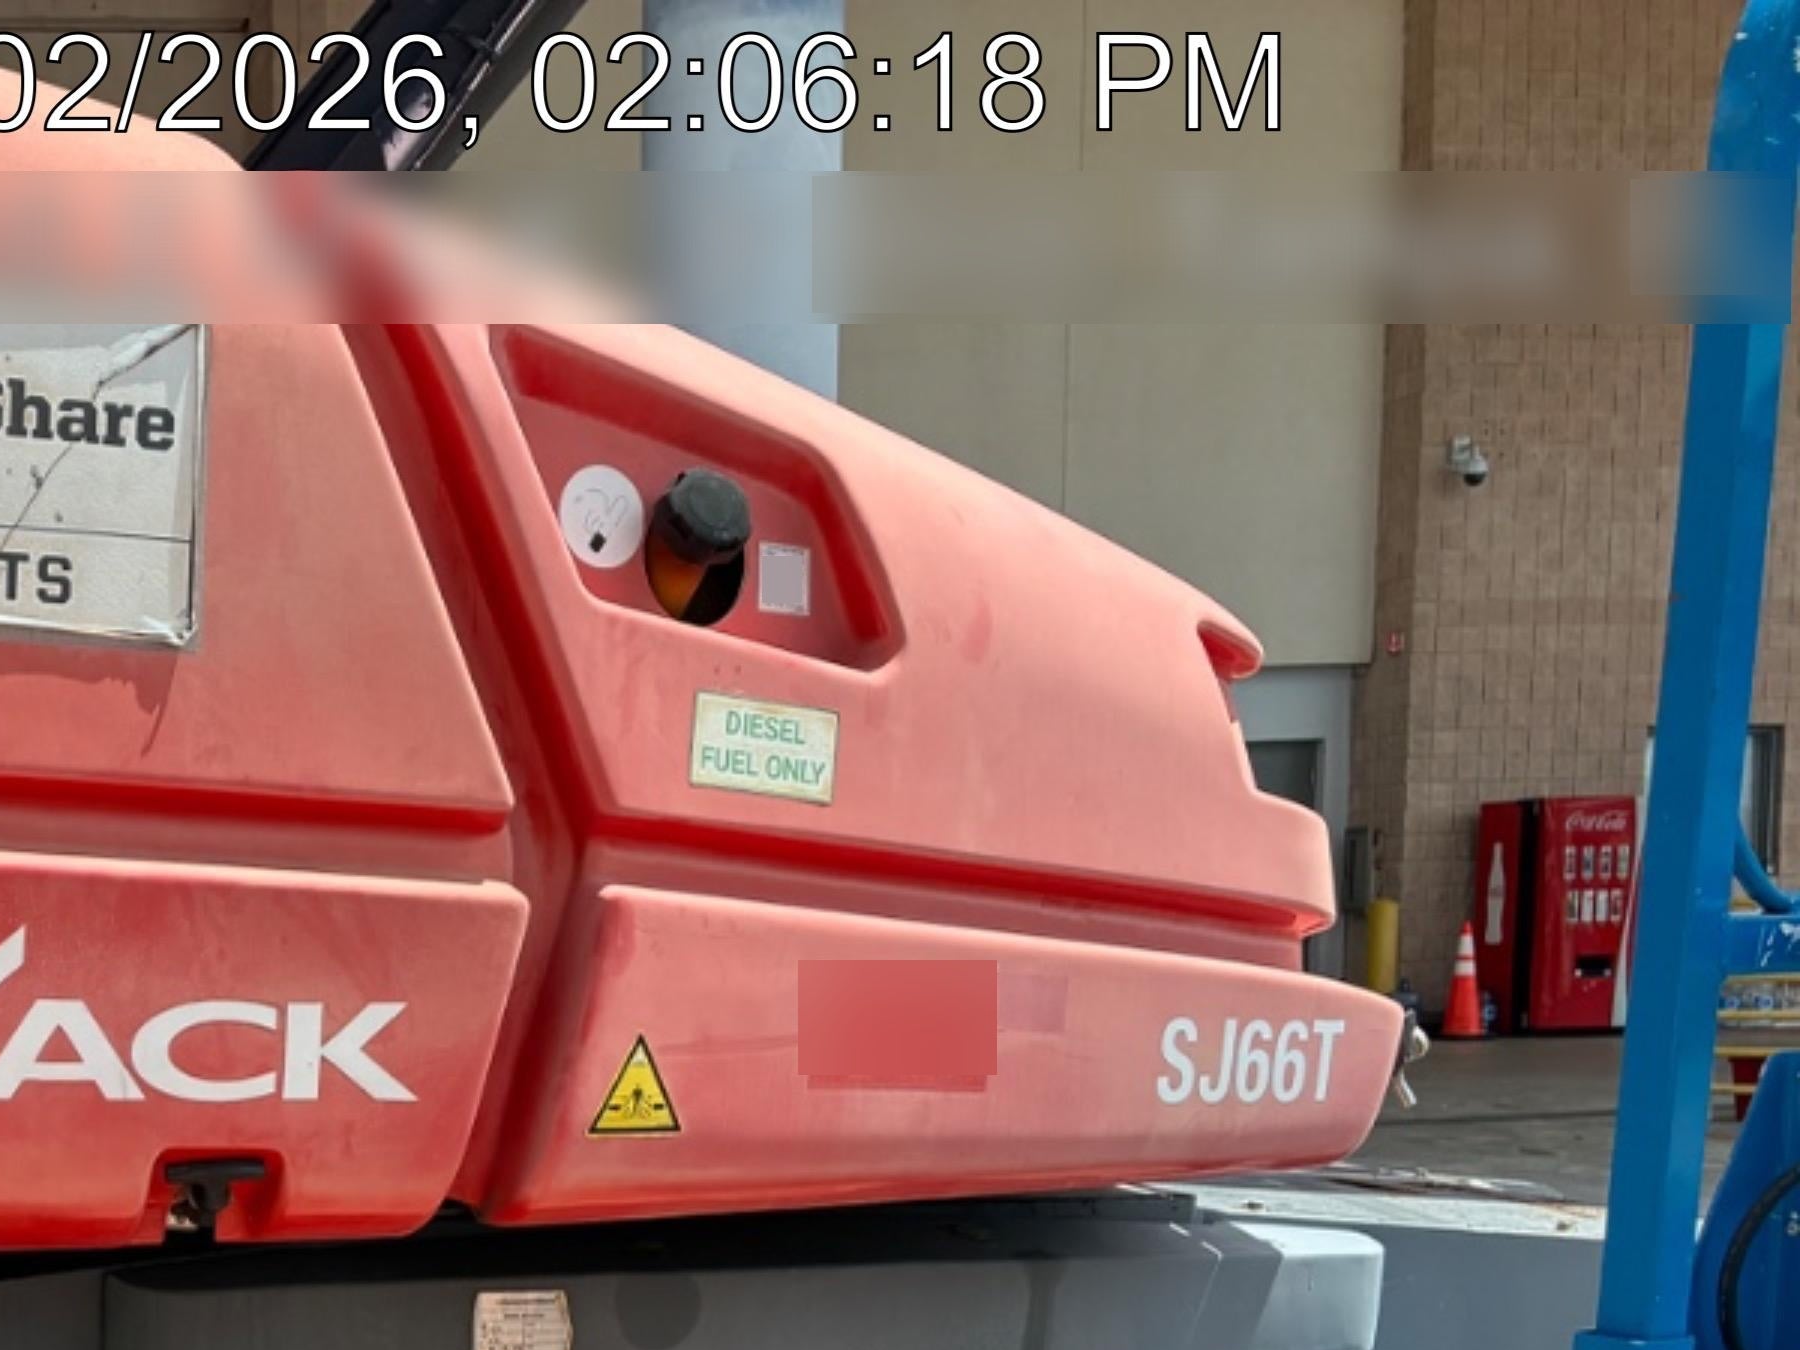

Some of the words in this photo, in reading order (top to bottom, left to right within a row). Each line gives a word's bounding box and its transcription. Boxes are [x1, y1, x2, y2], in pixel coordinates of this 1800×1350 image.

[726, 710, 805, 745] DIESEL
[701, 746, 758, 776] FUEL
[766, 755, 825, 785] ONLY
[1155, 1016, 1346, 1106] SJ66T
